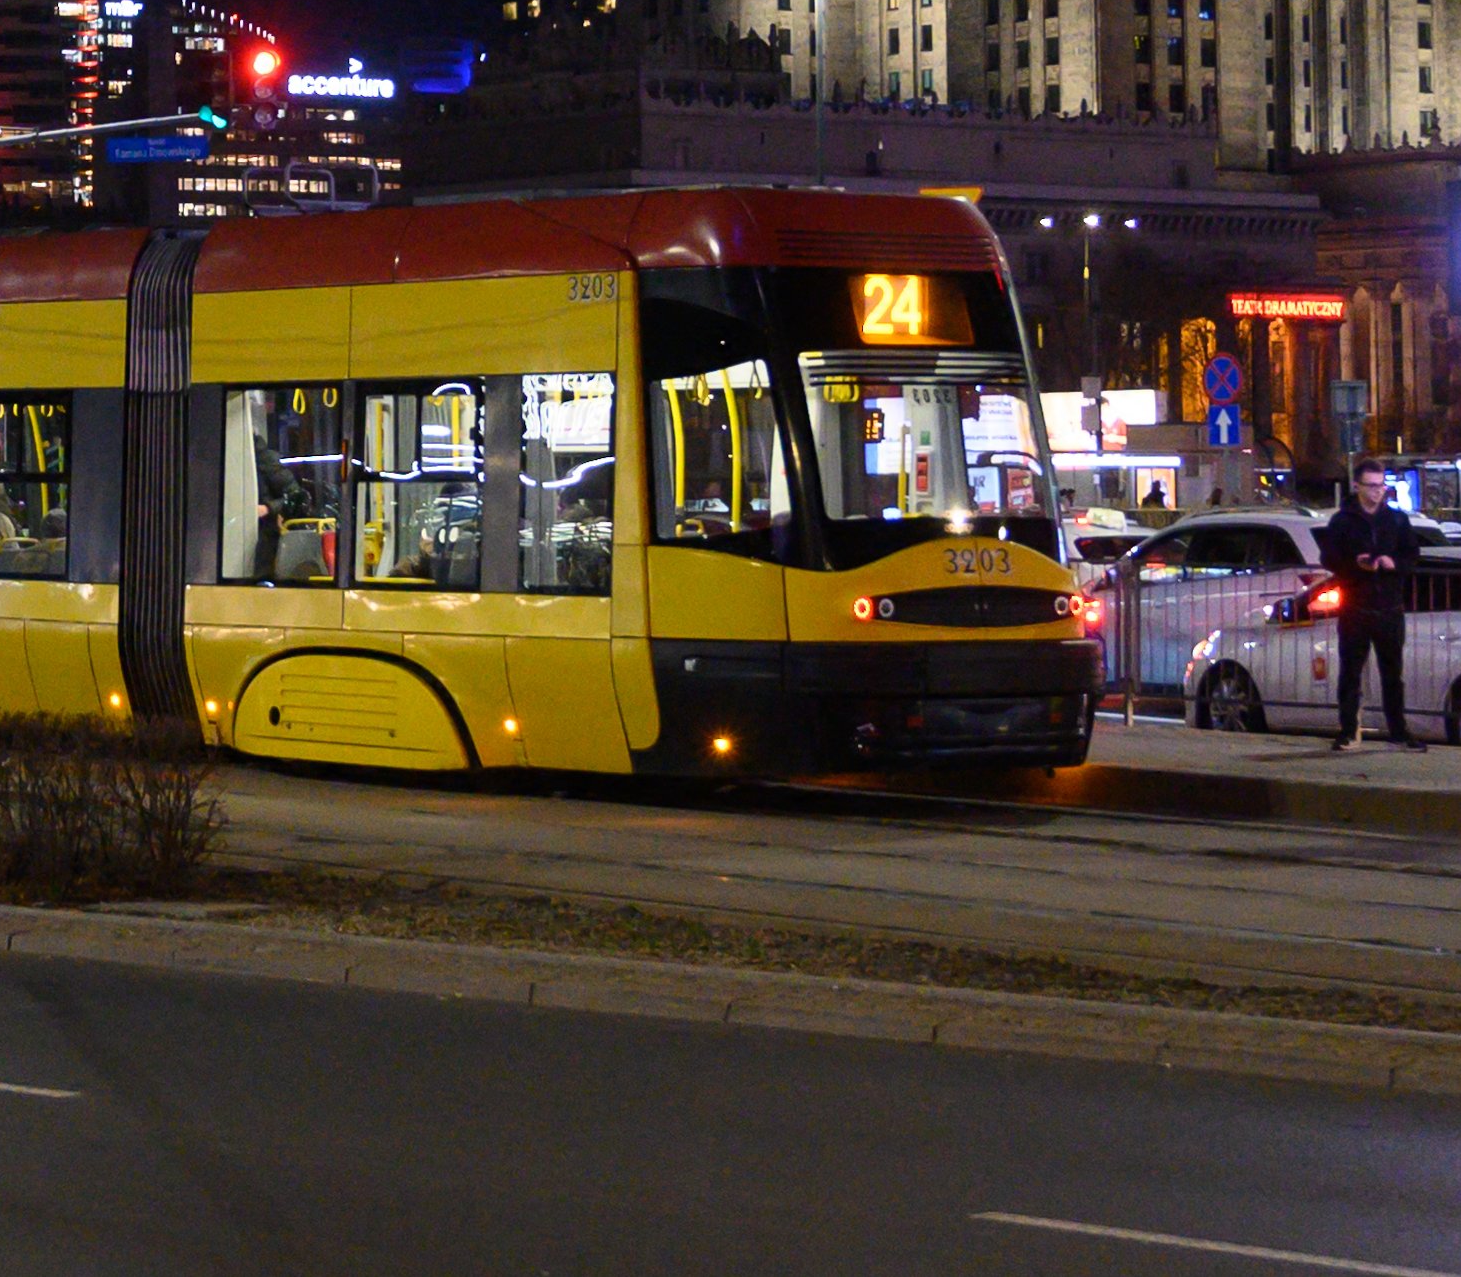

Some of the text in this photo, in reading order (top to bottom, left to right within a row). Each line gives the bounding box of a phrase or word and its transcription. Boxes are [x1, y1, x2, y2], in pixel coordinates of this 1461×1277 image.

[287, 74, 395, 98] accenture
[567, 275, 617, 302] 3203
[862, 274, 922, 336] 24
[1231, 299, 1343, 317] TEATR DRAMATYCZNY
[943, 548, 1011, 574] 3203
